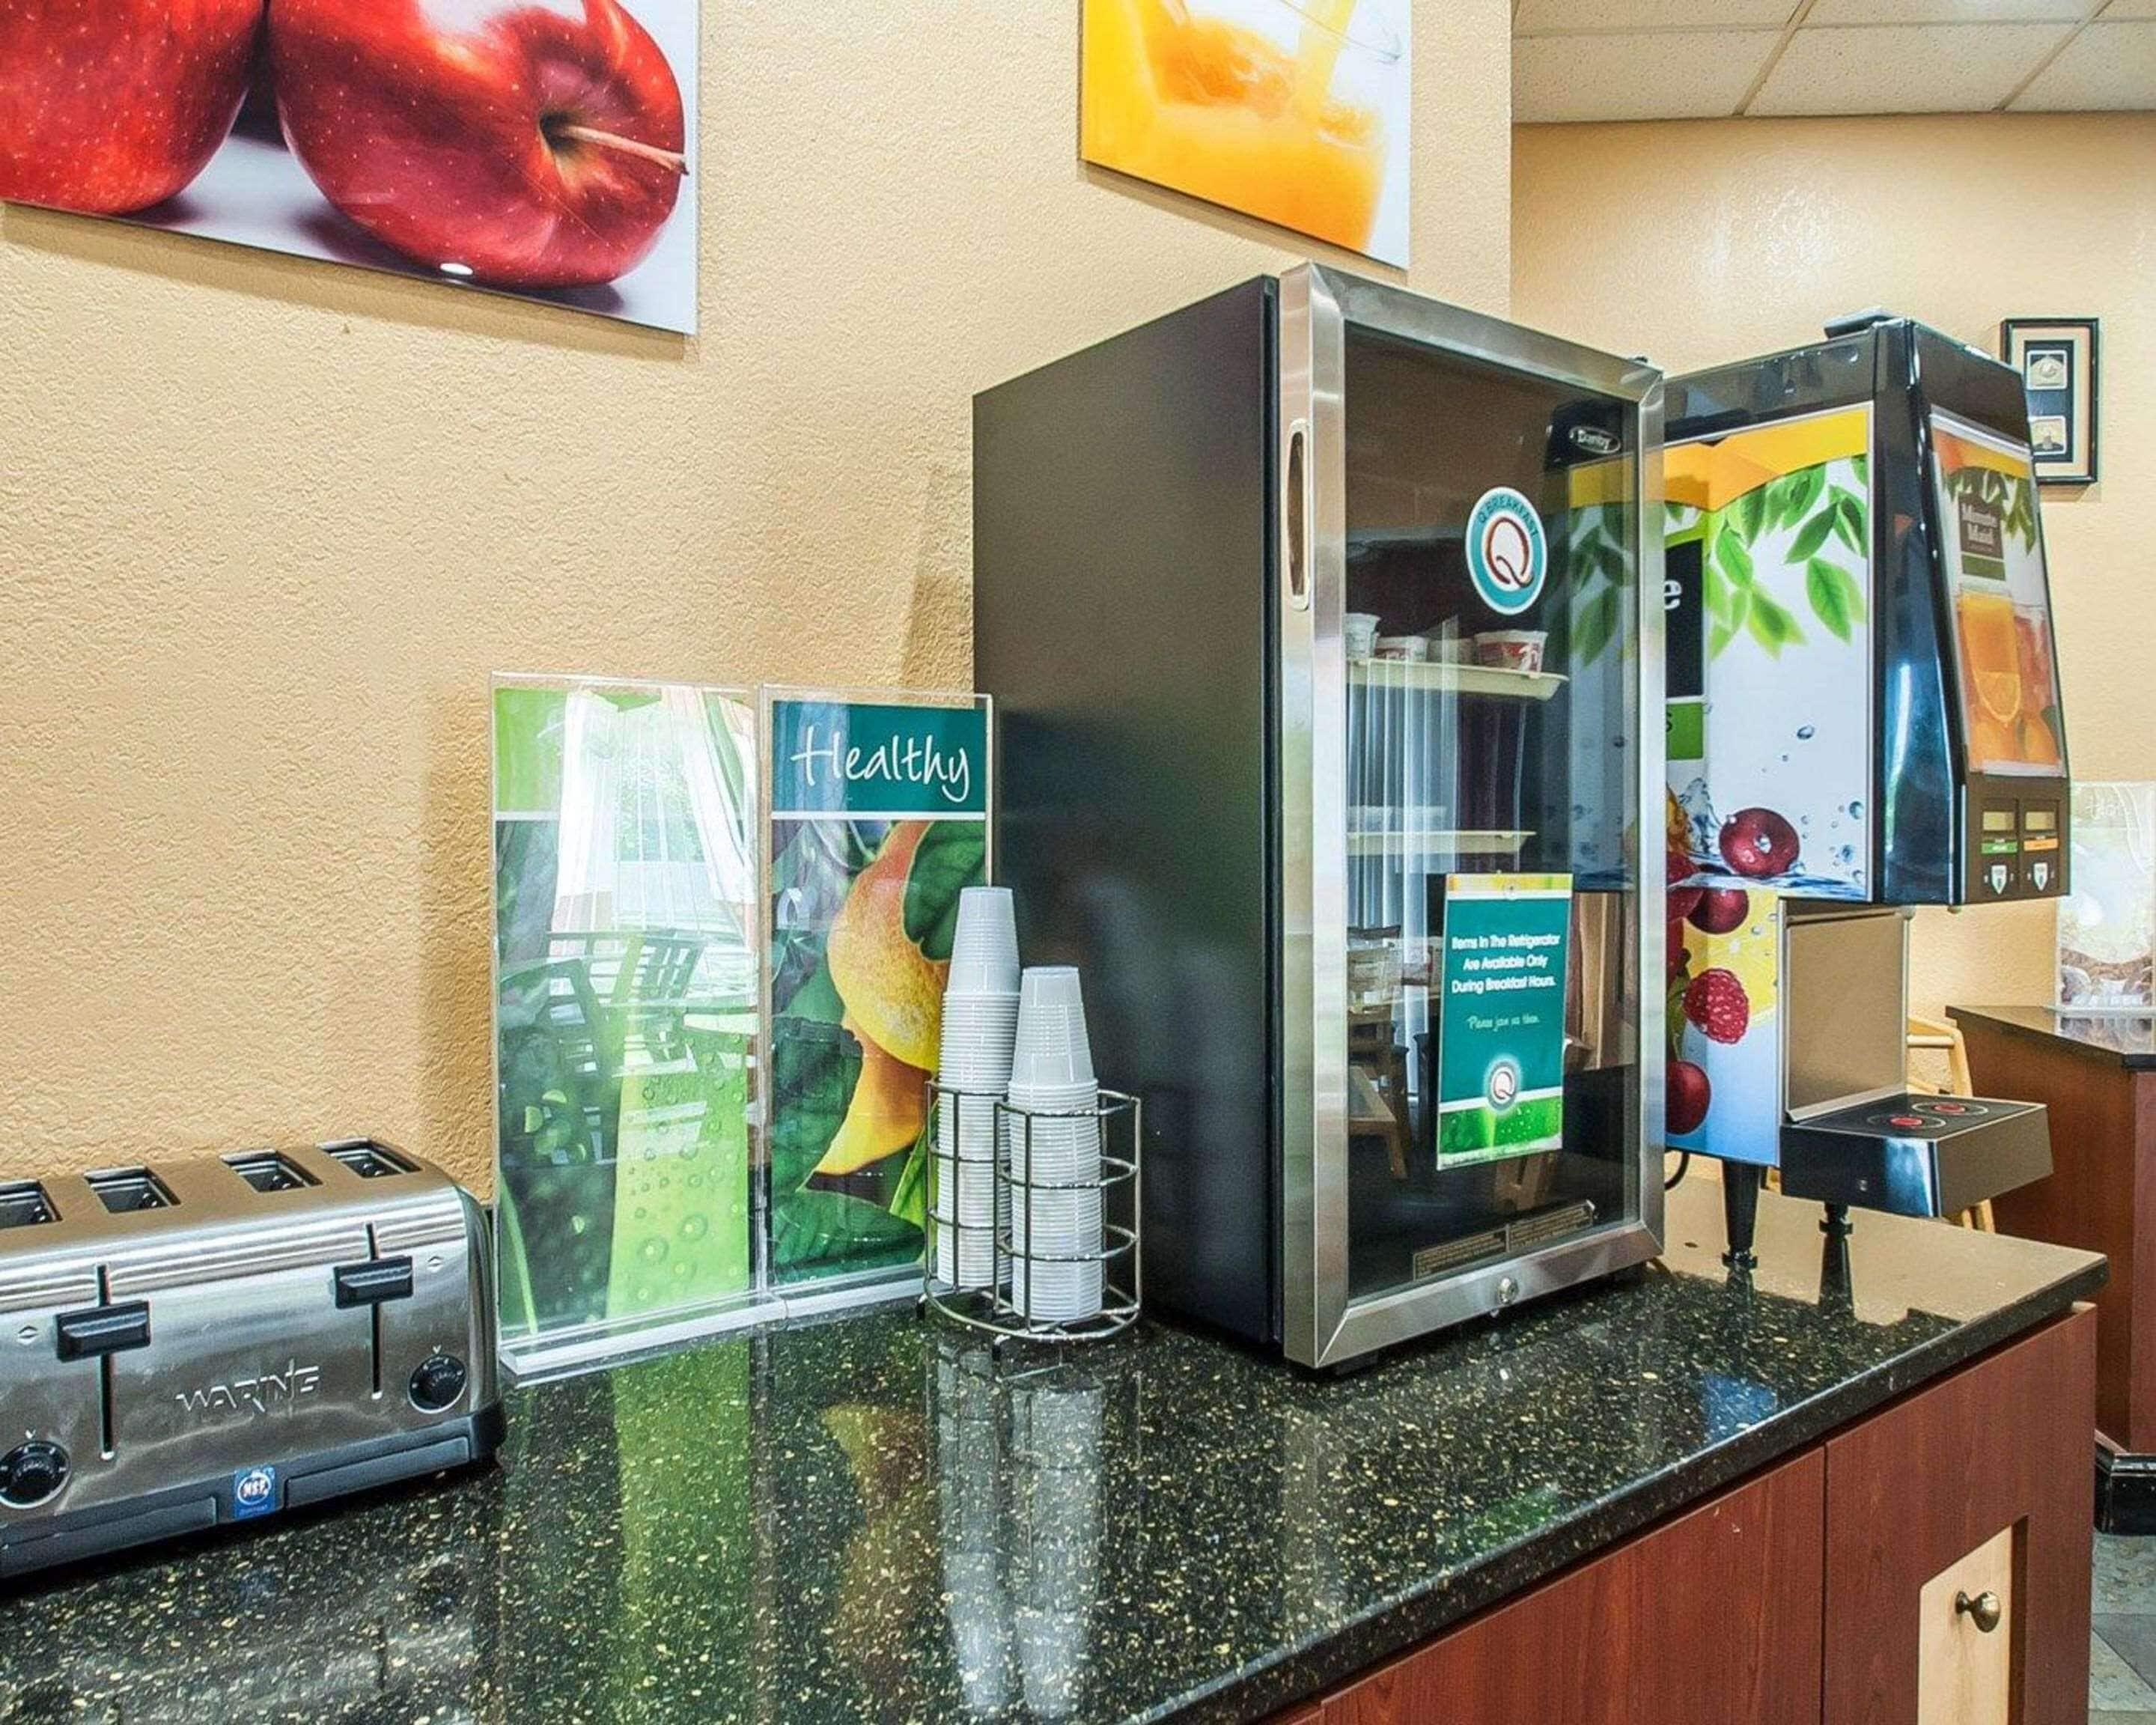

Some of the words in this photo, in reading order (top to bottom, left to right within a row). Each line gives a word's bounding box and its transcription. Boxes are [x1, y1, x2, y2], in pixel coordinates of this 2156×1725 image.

[1485, 495, 1540, 537] BREAKFAST
[1486, 517, 1535, 588] Q
[790, 725, 970, 803] Healthy
[1452, 936, 1478, 949] Items
[1479, 935, 1489, 948] In
[1489, 934, 1507, 948] The
[1507, 933, 1561, 949] Refrigerator
[1463, 958, 1480, 970] Are
[1481, 955, 1525, 970] Available
[1526, 953, 1549, 969] Only
[1452, 979, 1484, 994] During
[1484, 976, 1527, 991] Breakfast
[1527, 975, 1557, 988] Hours.
